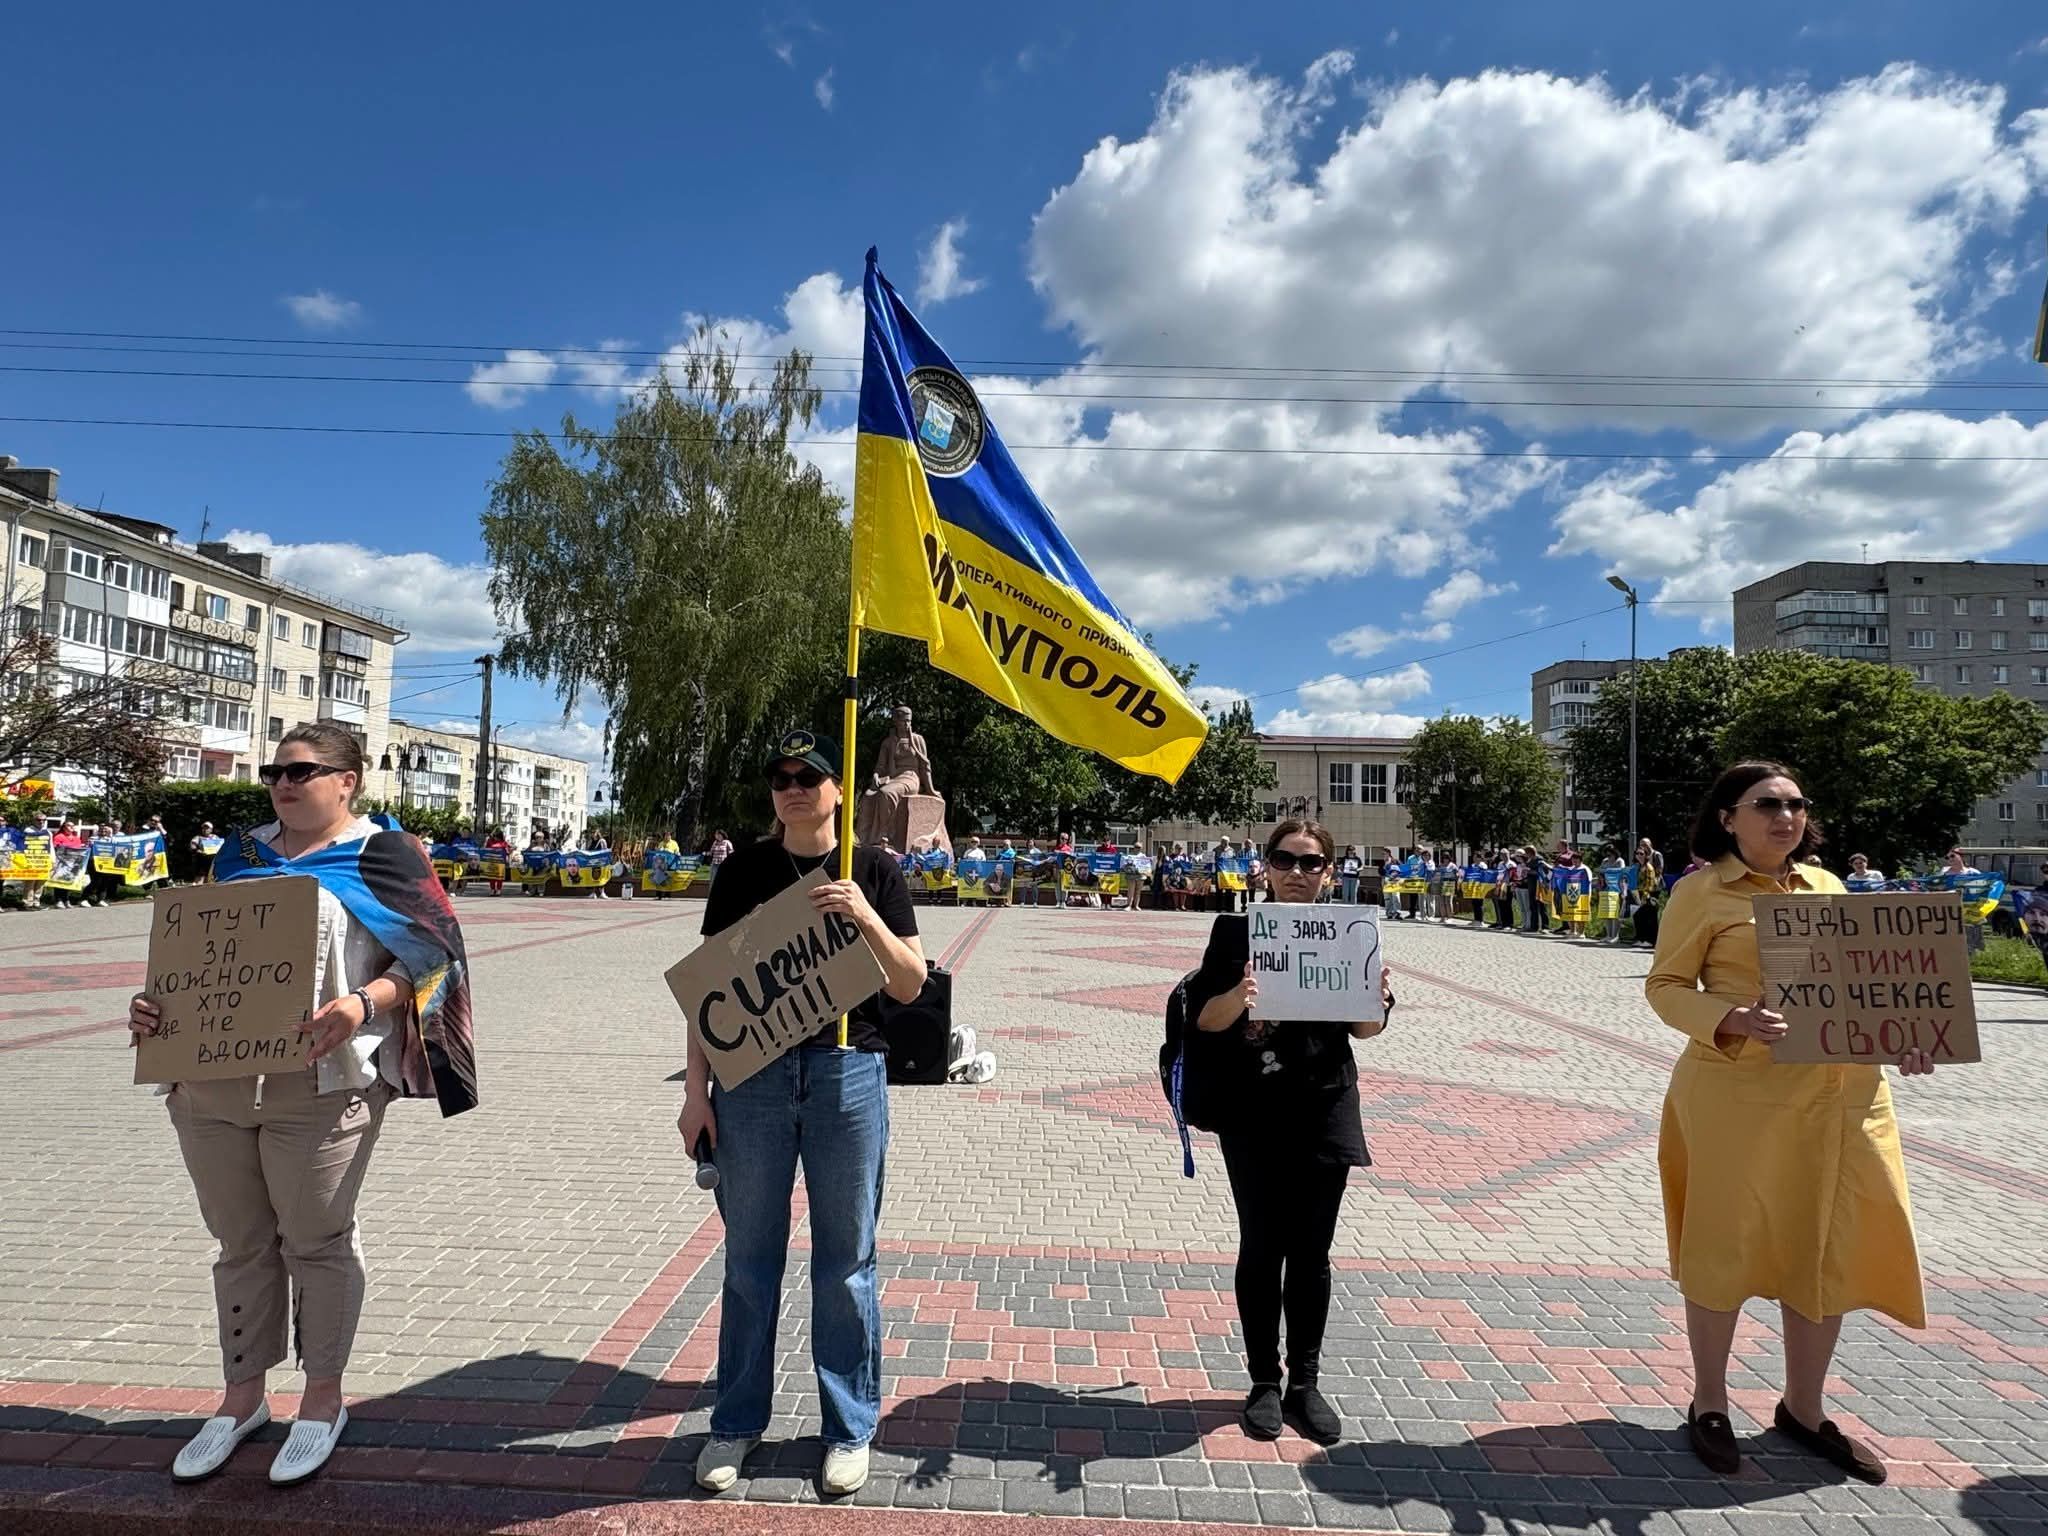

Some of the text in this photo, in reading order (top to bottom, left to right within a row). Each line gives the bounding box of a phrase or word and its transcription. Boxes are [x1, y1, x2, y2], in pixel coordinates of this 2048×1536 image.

[956, 559, 1137, 660] ОПЕРАТИВНОГО ПРИЗН
[164, 903, 276, 938] Я ТУТ
[1252, 912, 1278, 939] Де
[1773, 905, 1963, 937] БУДЬ ПОРУЧ
[203, 938, 237, 965] ЗА
[1846, 948, 1940, 975] ТИМИ
[197, 991, 242, 1012] ХТО
[1777, 982, 1955, 1010] ХТО ЧЕКАЄ
[1820, 1016, 1954, 1058] СВОЇХ
